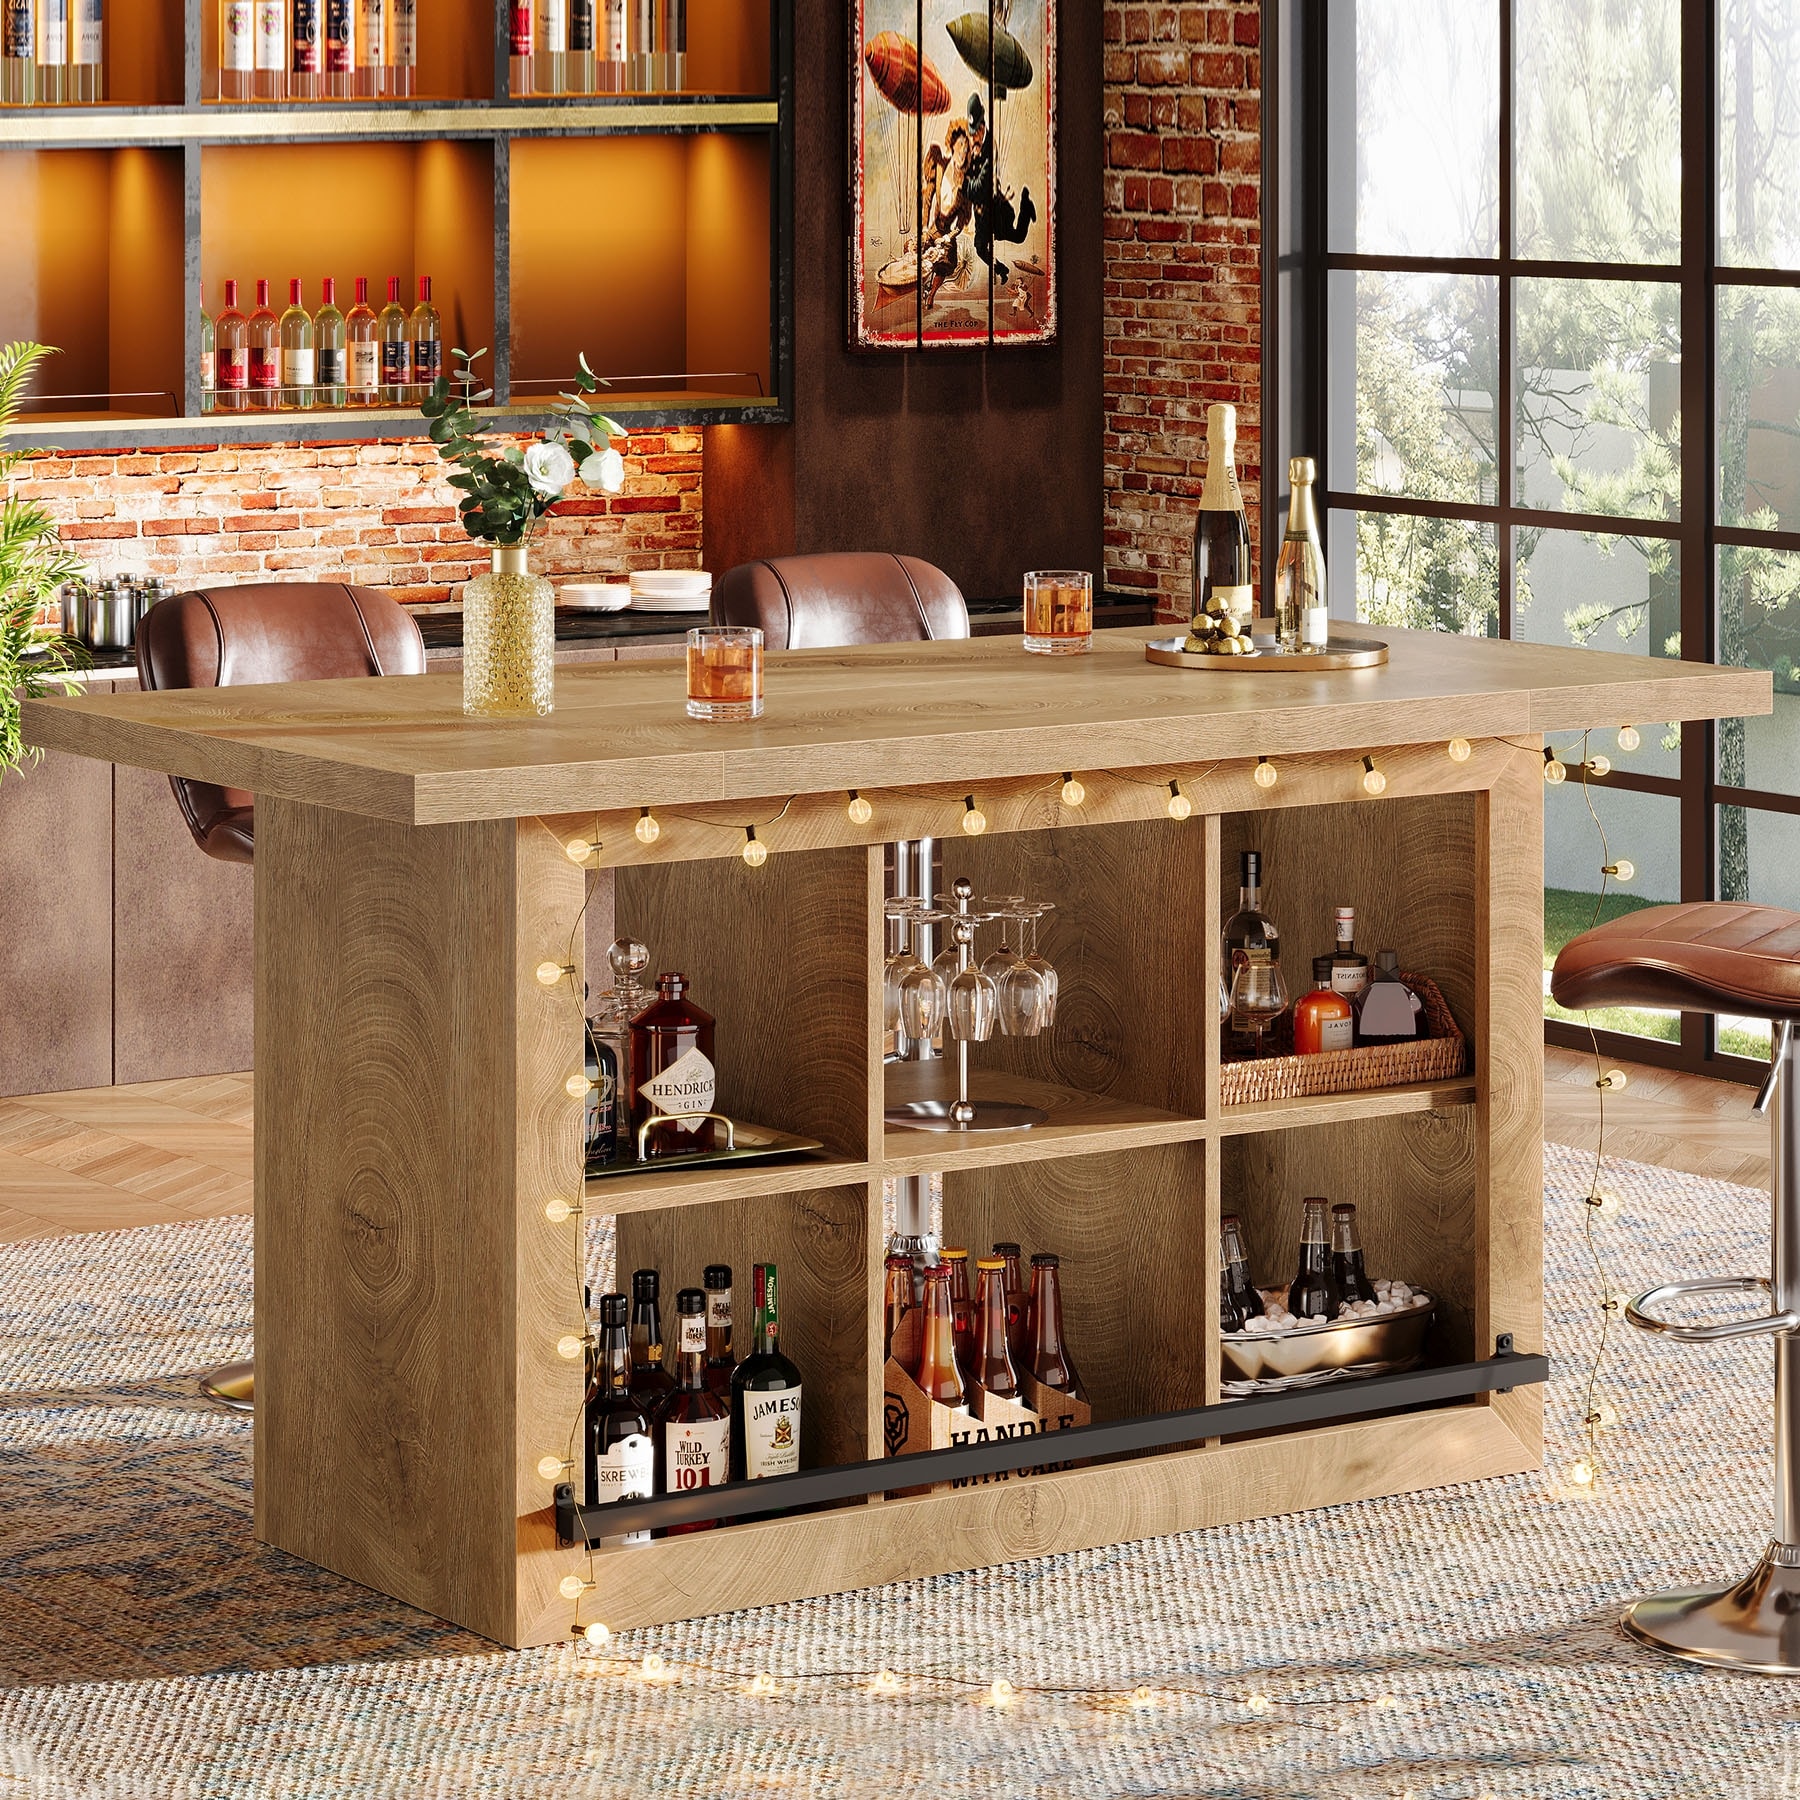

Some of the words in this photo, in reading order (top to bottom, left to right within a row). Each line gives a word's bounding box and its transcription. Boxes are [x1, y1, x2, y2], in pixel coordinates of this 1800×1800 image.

[950, 320, 963, 328] FLY
[964, 320, 979, 328] COP
[683, 1099, 703, 1109] GIN
[766, 1276, 775, 1314] JAMESON
[679, 1441, 702, 1454] WILD
[675, 1451, 711, 1467] TURKEY
[675, 1466, 710, 1490] 101
